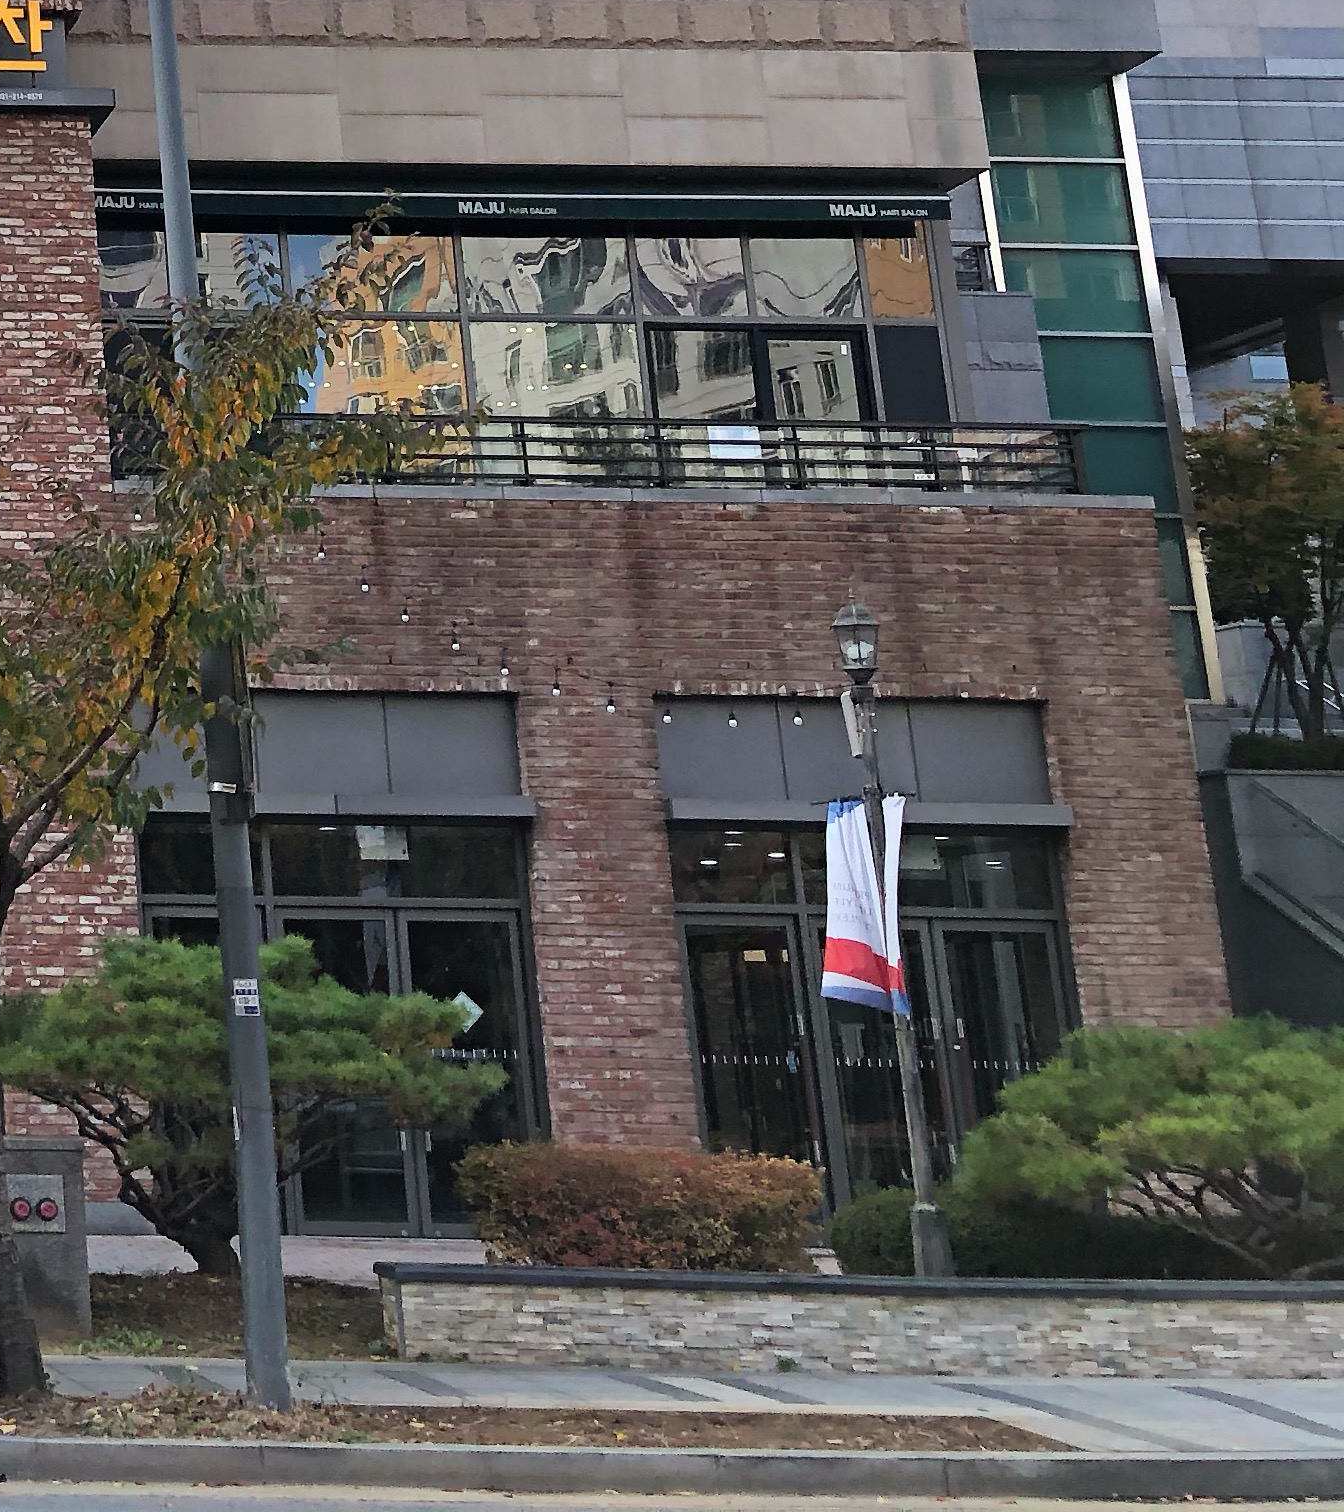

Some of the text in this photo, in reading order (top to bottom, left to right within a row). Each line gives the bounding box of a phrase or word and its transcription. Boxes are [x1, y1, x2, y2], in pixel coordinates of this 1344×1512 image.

[458, 201, 558, 215] MAJU HAIR SALON
[829, 203, 929, 217] MAJU HAIR SALON
